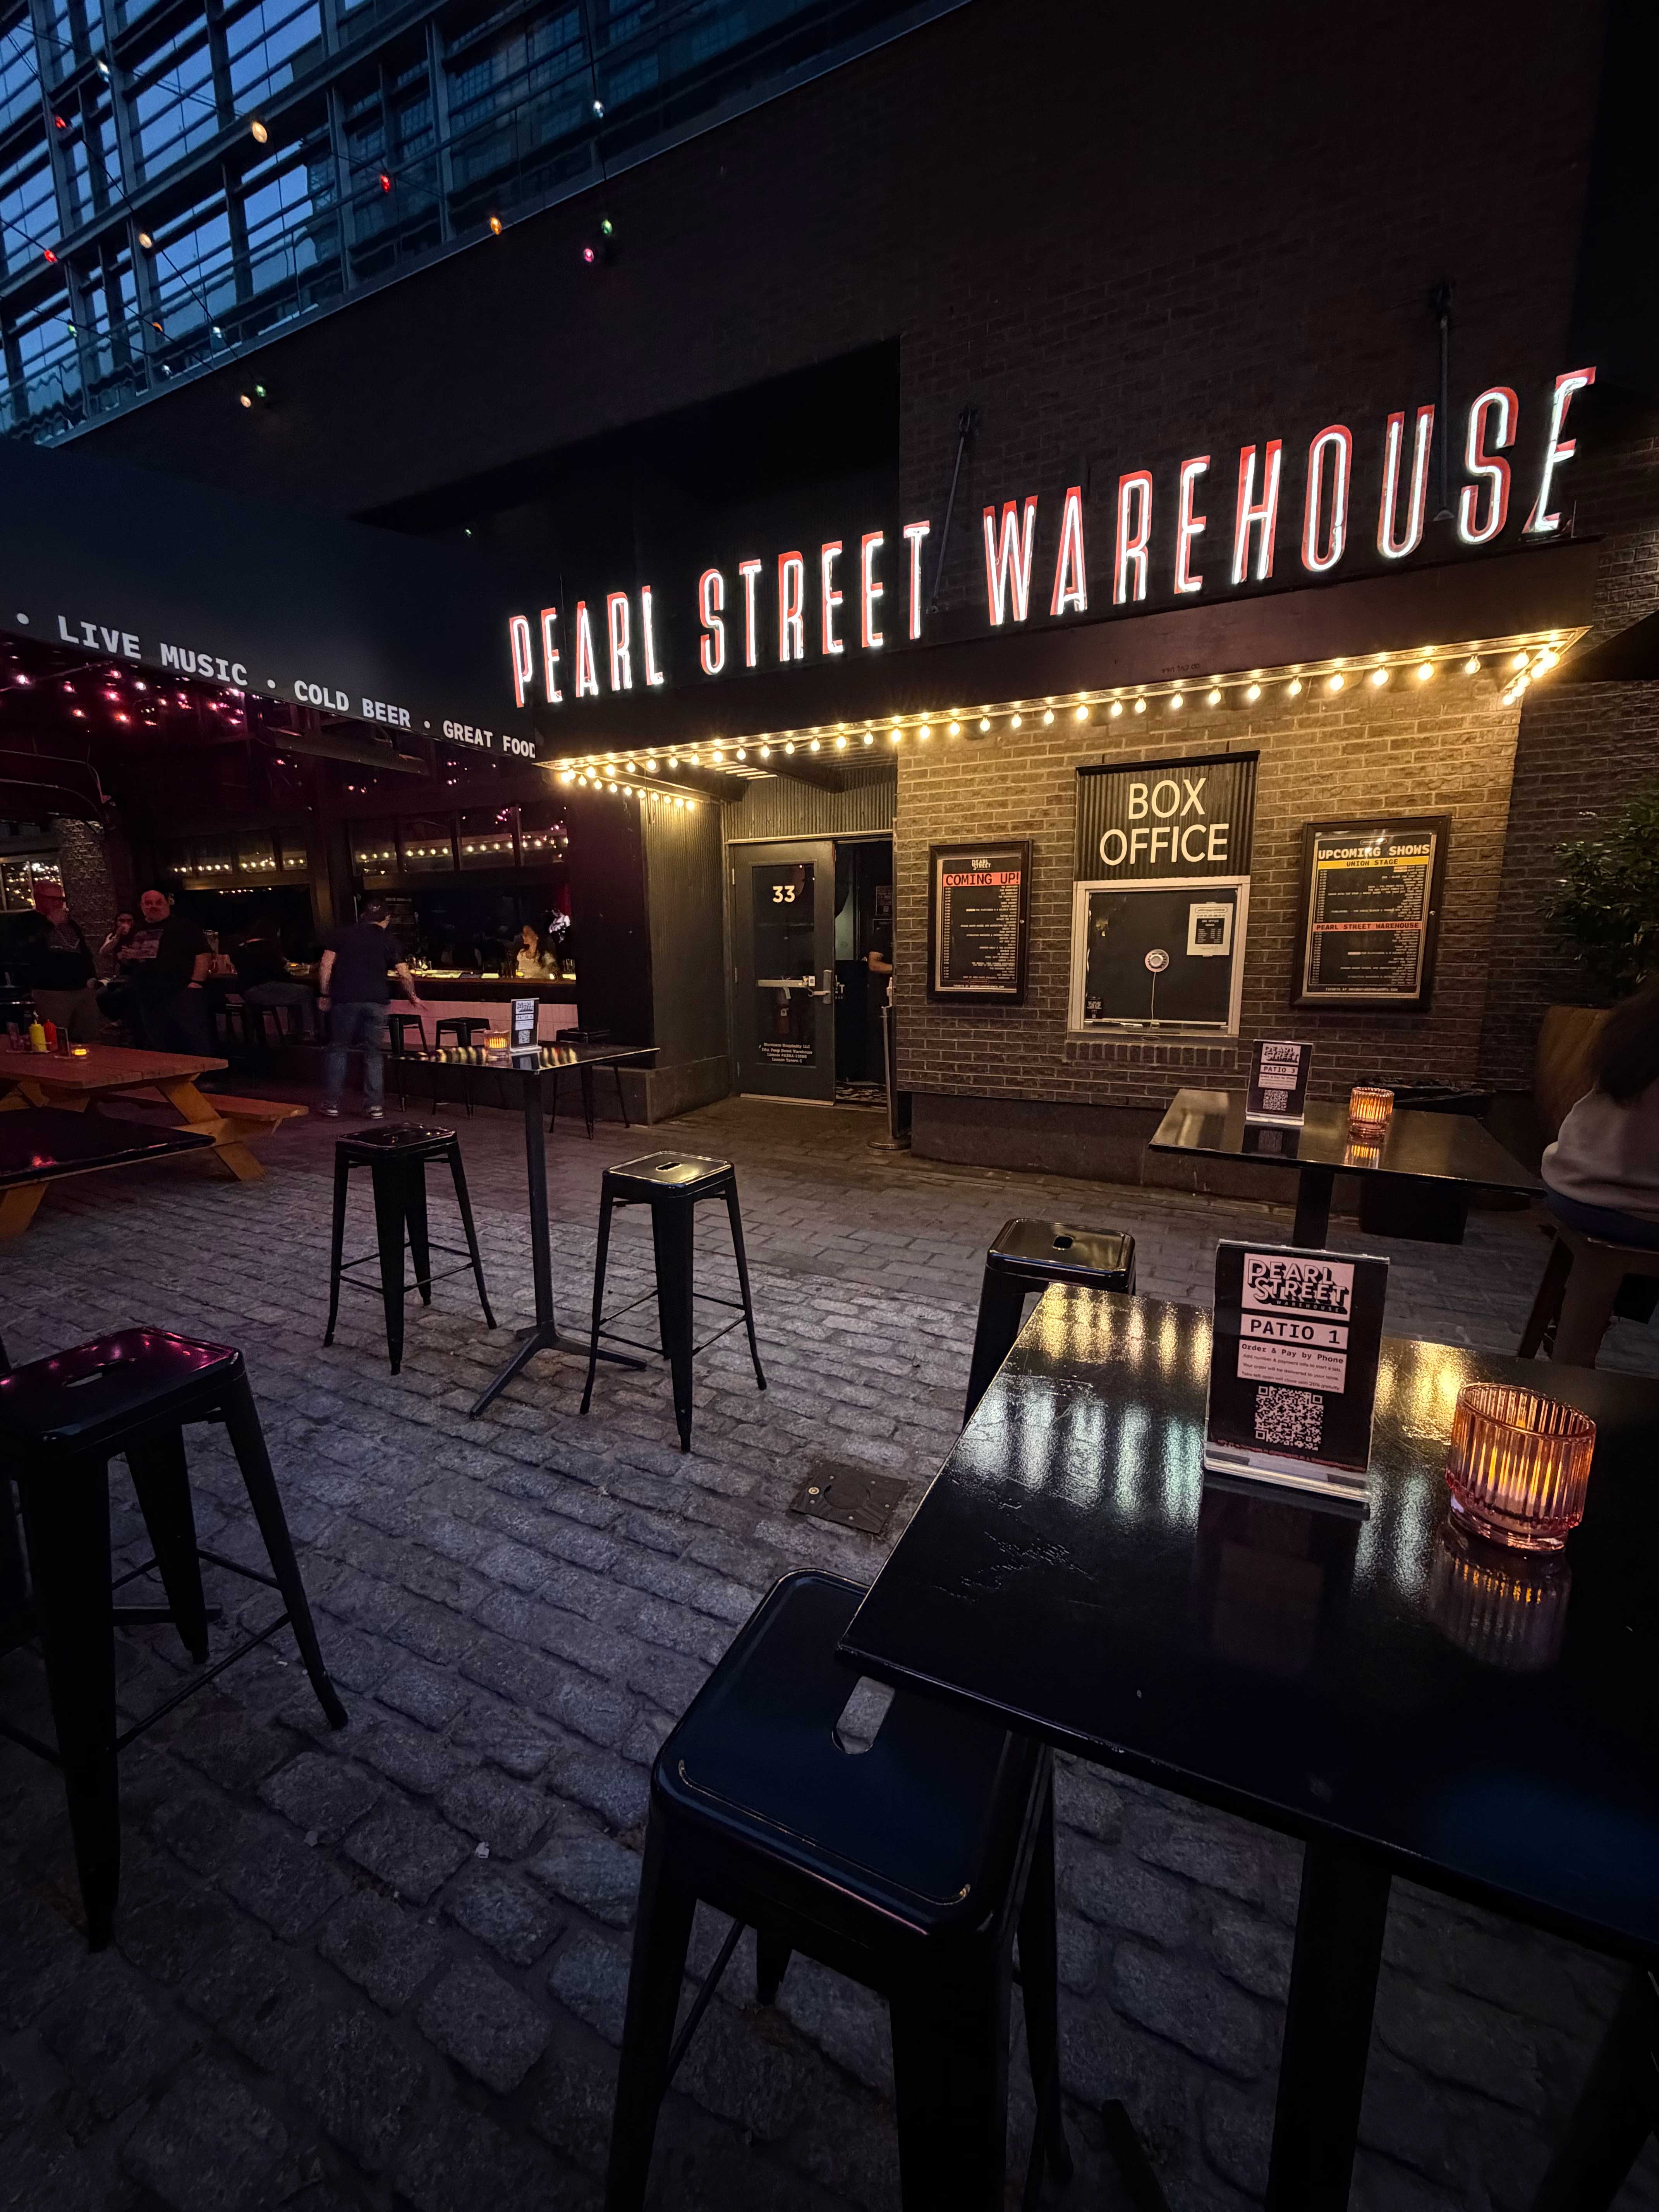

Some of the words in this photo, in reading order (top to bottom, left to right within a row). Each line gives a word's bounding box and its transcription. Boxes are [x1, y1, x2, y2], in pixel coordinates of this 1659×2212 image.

[509, 586, 664, 708] PEARL
[699, 520, 930, 675] STREET
[983, 366, 1597, 625] WAREHOUSE
[58, 615, 141, 659] LIVE
[160, 642, 248, 686] MUSIC
[294, 680, 349, 711] COLD
[362, 698, 411, 728] BEER
[443, 720, 493, 748] GREAT
[503, 735, 536, 758] FOOD
[1128, 777, 1207, 820] BOX
[1099, 823, 1230, 866] OFFICE
[1318, 847, 1381, 860] UPCOMING
[1389, 844, 1430, 856] SHOWS
[946, 874, 992, 885] COMING
[1000, 872, 1018, 884] UP!
[772, 885, 795, 903] 33
[1248, 1259, 1334, 1286] PEARL
[1254, 1278, 1349, 1304] STREET
[1276, 1300, 1340, 1312] WAREHOUSE
[1251, 1319, 1314, 1340] PATIO
[1329, 1330, 1340, 1344] 1
[1242, 1344, 1267, 1352] Order
[1282, 1349, 1296, 1357] Pay
[1317, 1354, 1344, 1364] Phone
